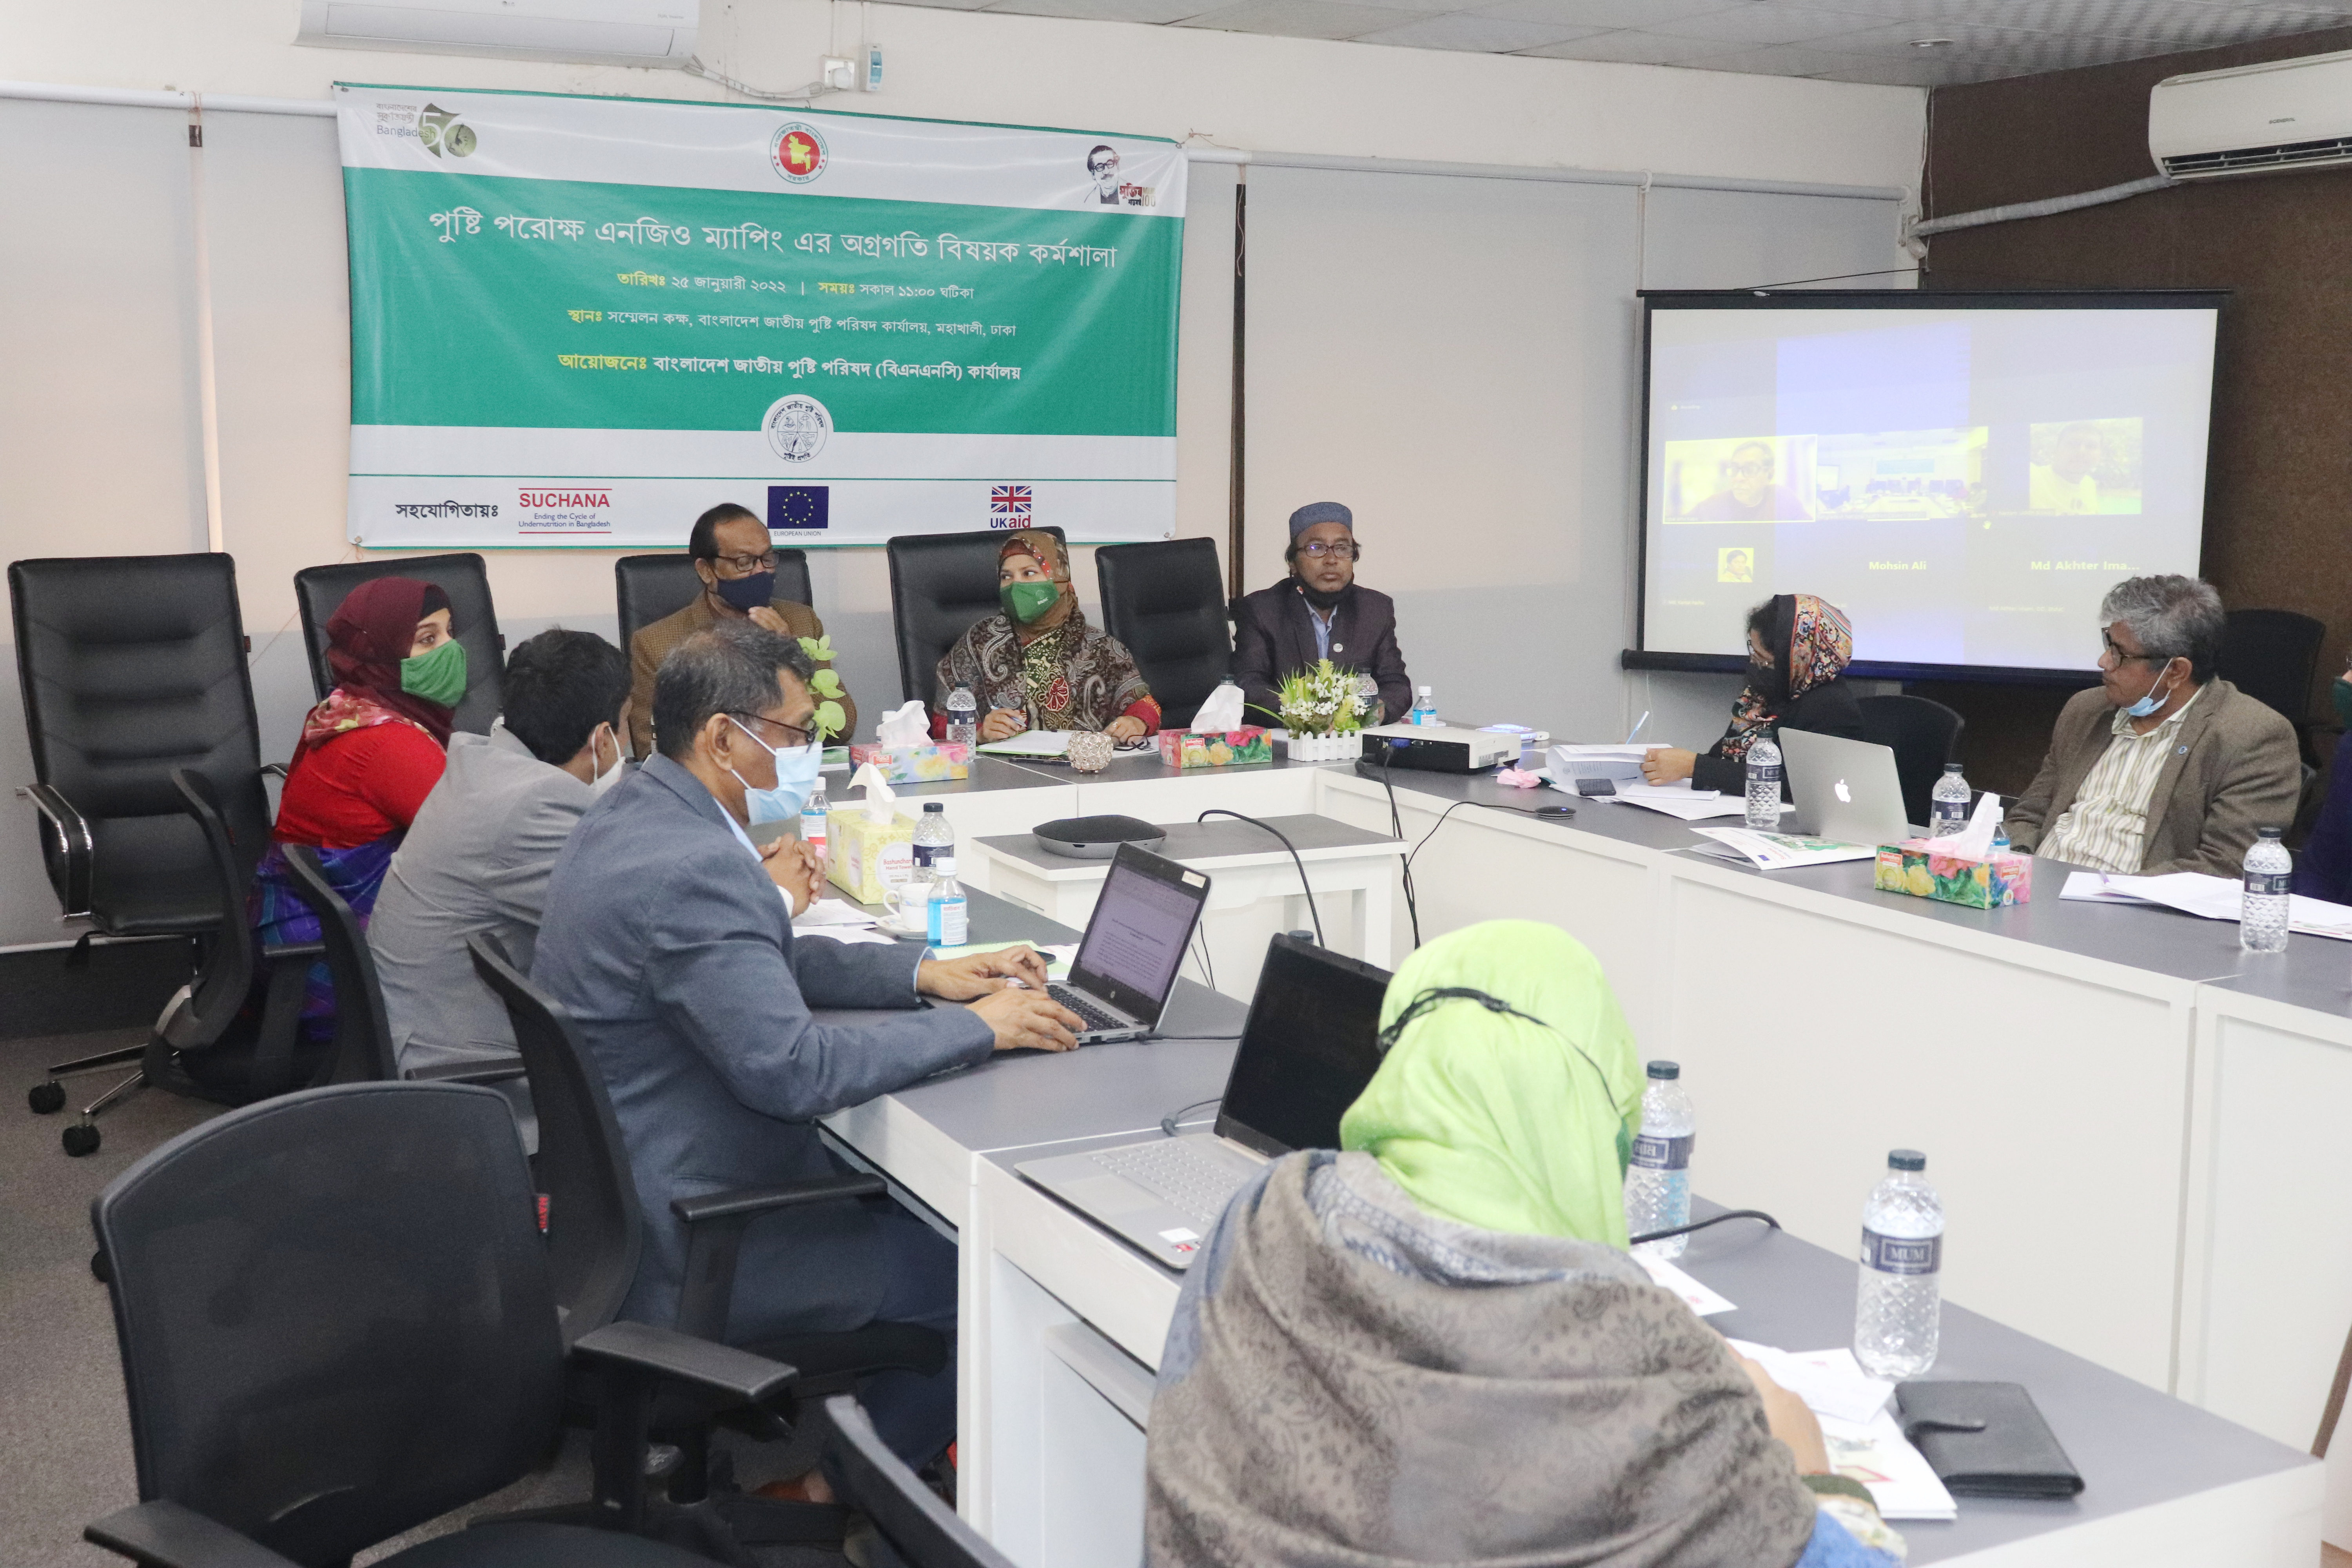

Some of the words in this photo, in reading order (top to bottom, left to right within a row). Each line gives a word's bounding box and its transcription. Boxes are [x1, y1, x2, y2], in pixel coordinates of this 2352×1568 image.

[377, 125, 435, 138] Bangladesh
[429, 206, 483, 243] পুষ্টি
[494, 214, 585, 241] পরোক্ষ
[595, 216, 691, 246] এনজিও
[701, 222, 783, 253] ম্যাপিং
[794, 233, 832, 254] এর
[840, 231, 929, 258] অগ্রগতি
[936, 233, 1020, 262] বিষয়ক
[1027, 238, 1118, 268] কর্মশালা
[671, 277, 689, 288] ২৫
[694, 276, 746, 292] জানুয়ারী
[751, 280, 786, 292] ২০২২
[860, 285, 894, 296] সকাল
[899, 286, 935, 297] ১১:০০
[940, 285, 974, 299] ঘটিকা
[607, 312, 658, 323] সম্মেলন
[662, 314, 693, 327] কক্ষ,
[698, 315, 759, 327] বাংলাদেশ
[764, 314, 804, 329] জাতীয়
[808, 316, 832, 333] পুষ্টি
[836, 317, 877, 330] পরিষদ
[881, 319, 931, 336] কার্যালয়,
[935, 321, 986, 337] মহাখালী,
[991, 325, 1016, 336] ঢাকা
[652, 356, 729, 372] বাংলাদেশ
[733, 356, 784, 374] জাতীয়
[788, 357, 817, 378] পুষ্টি
[821, 358, 872, 377] পরিষদ
[875, 359, 962, 381] (বিএনএনসি)
[967, 362, 1022, 380] কার্যালয়
[520, 493, 610, 507] SUCHANA
[1869, 561, 1908, 570] Mohsin
[1911, 561, 1927, 570] Ali
[2031, 561, 2051, 570] Md
[2055, 561, 2099, 570] Akhter
[1891, 1247, 1924, 1260] MUM
